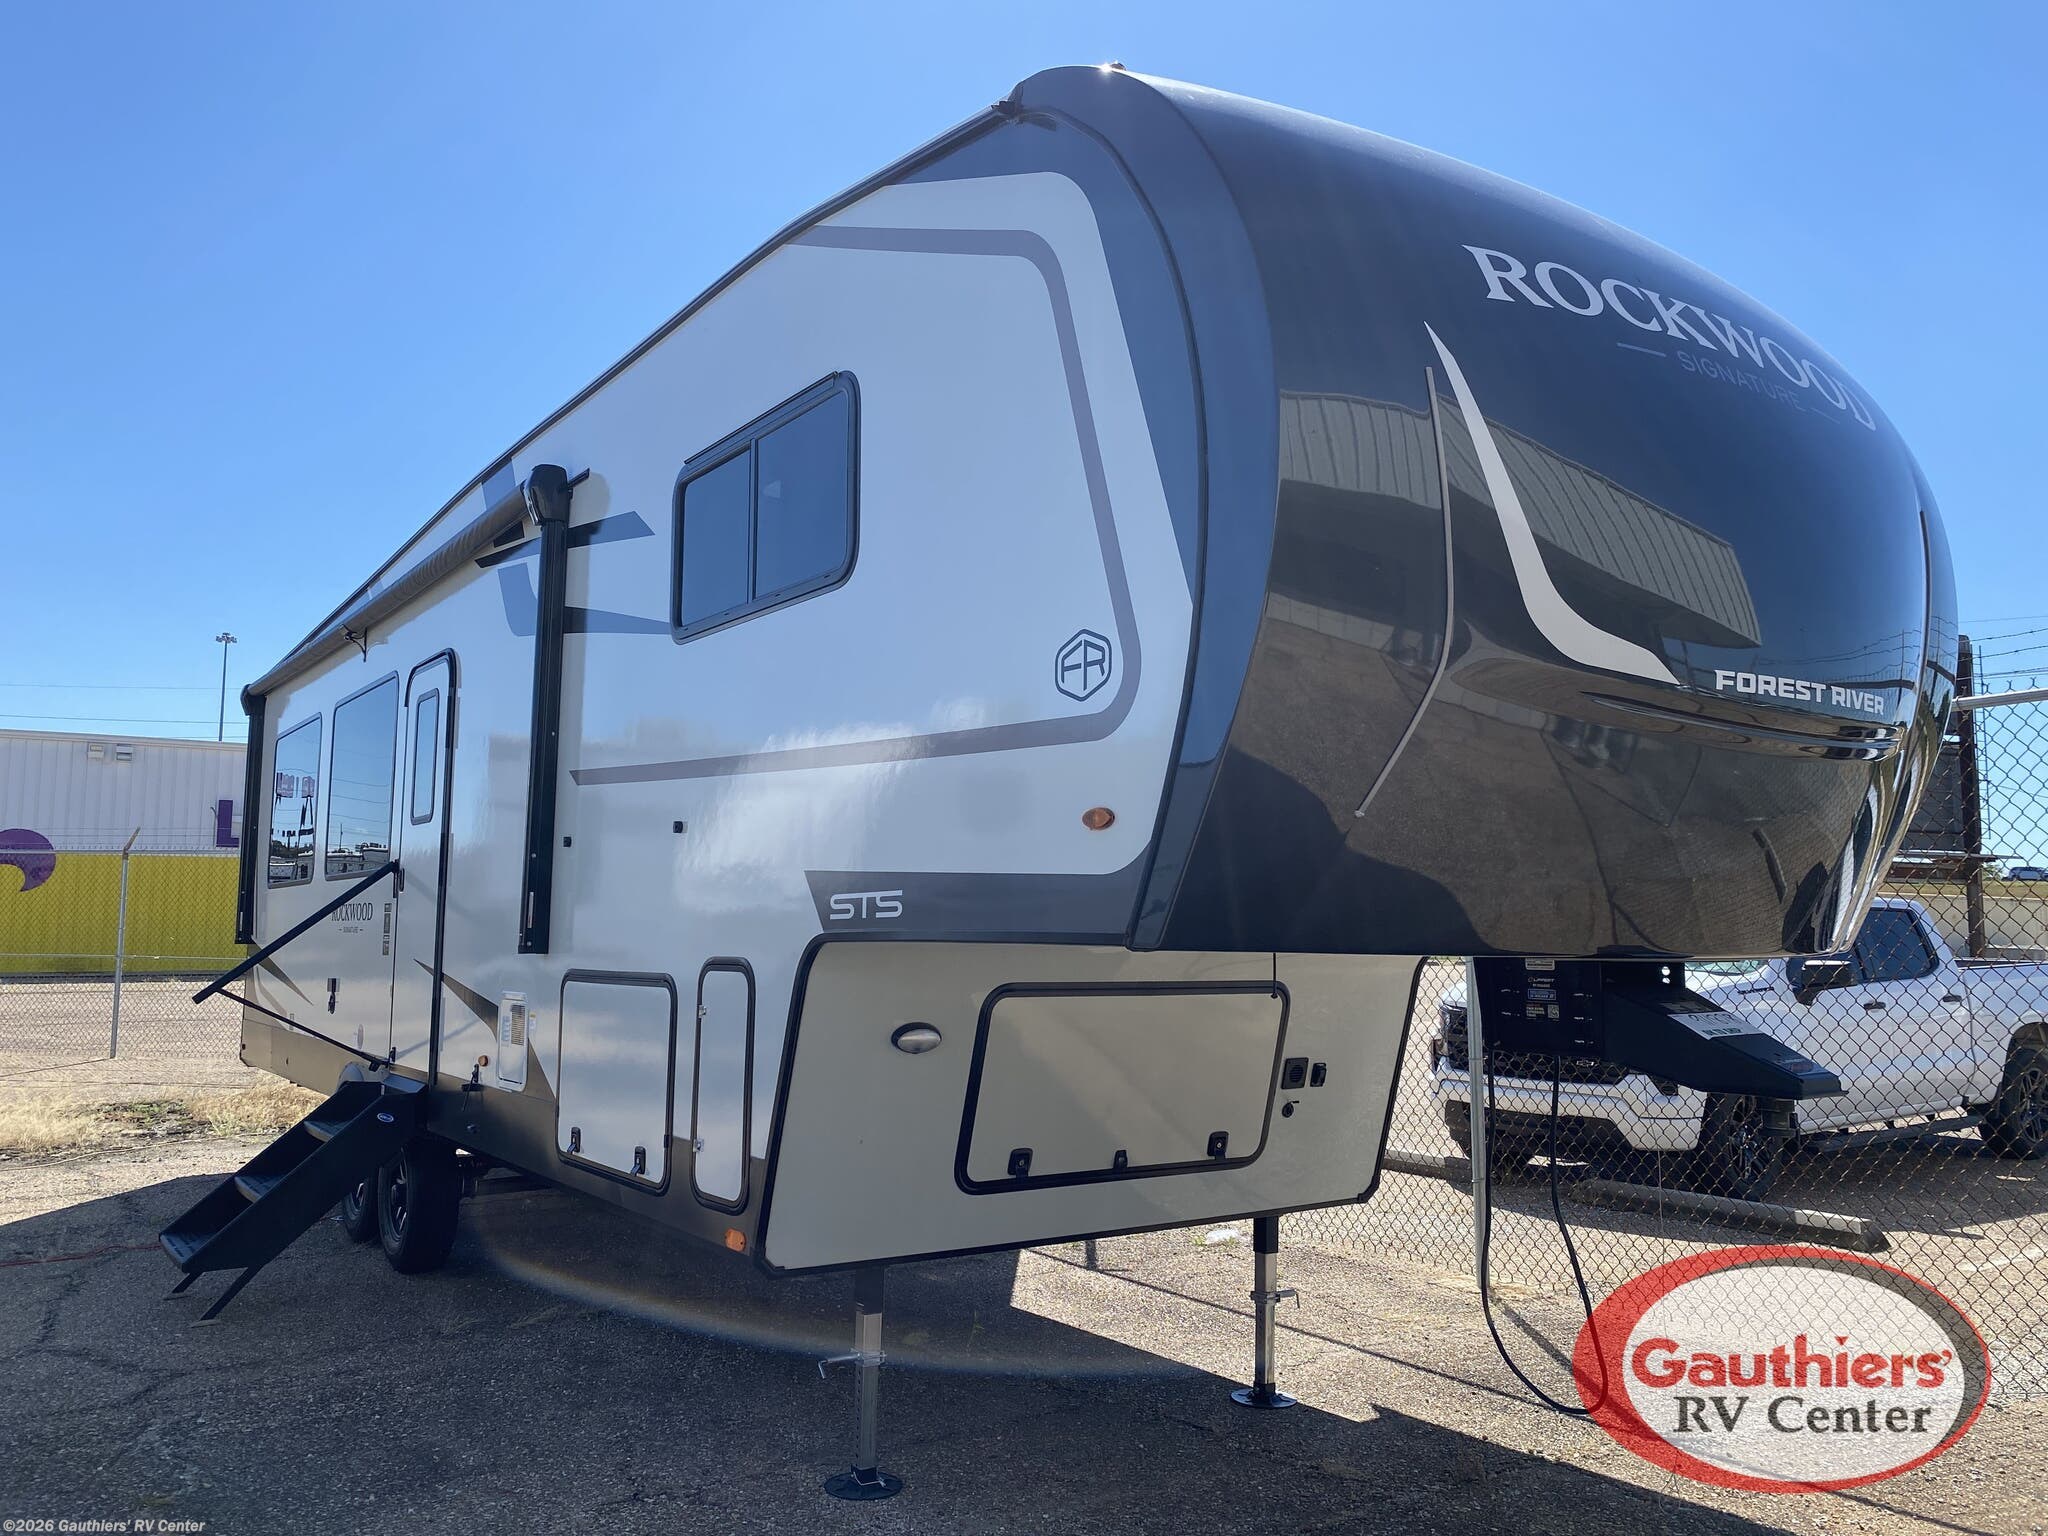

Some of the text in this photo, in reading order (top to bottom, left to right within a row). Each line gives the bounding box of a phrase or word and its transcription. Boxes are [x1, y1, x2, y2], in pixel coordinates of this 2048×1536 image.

[1461, 244, 1877, 432] ROCKWOOD
[1676, 350, 1805, 411] SIGNATURE
[1714, 669, 1885, 716] FOREST RIVER
[829, 889, 903, 920] STS
